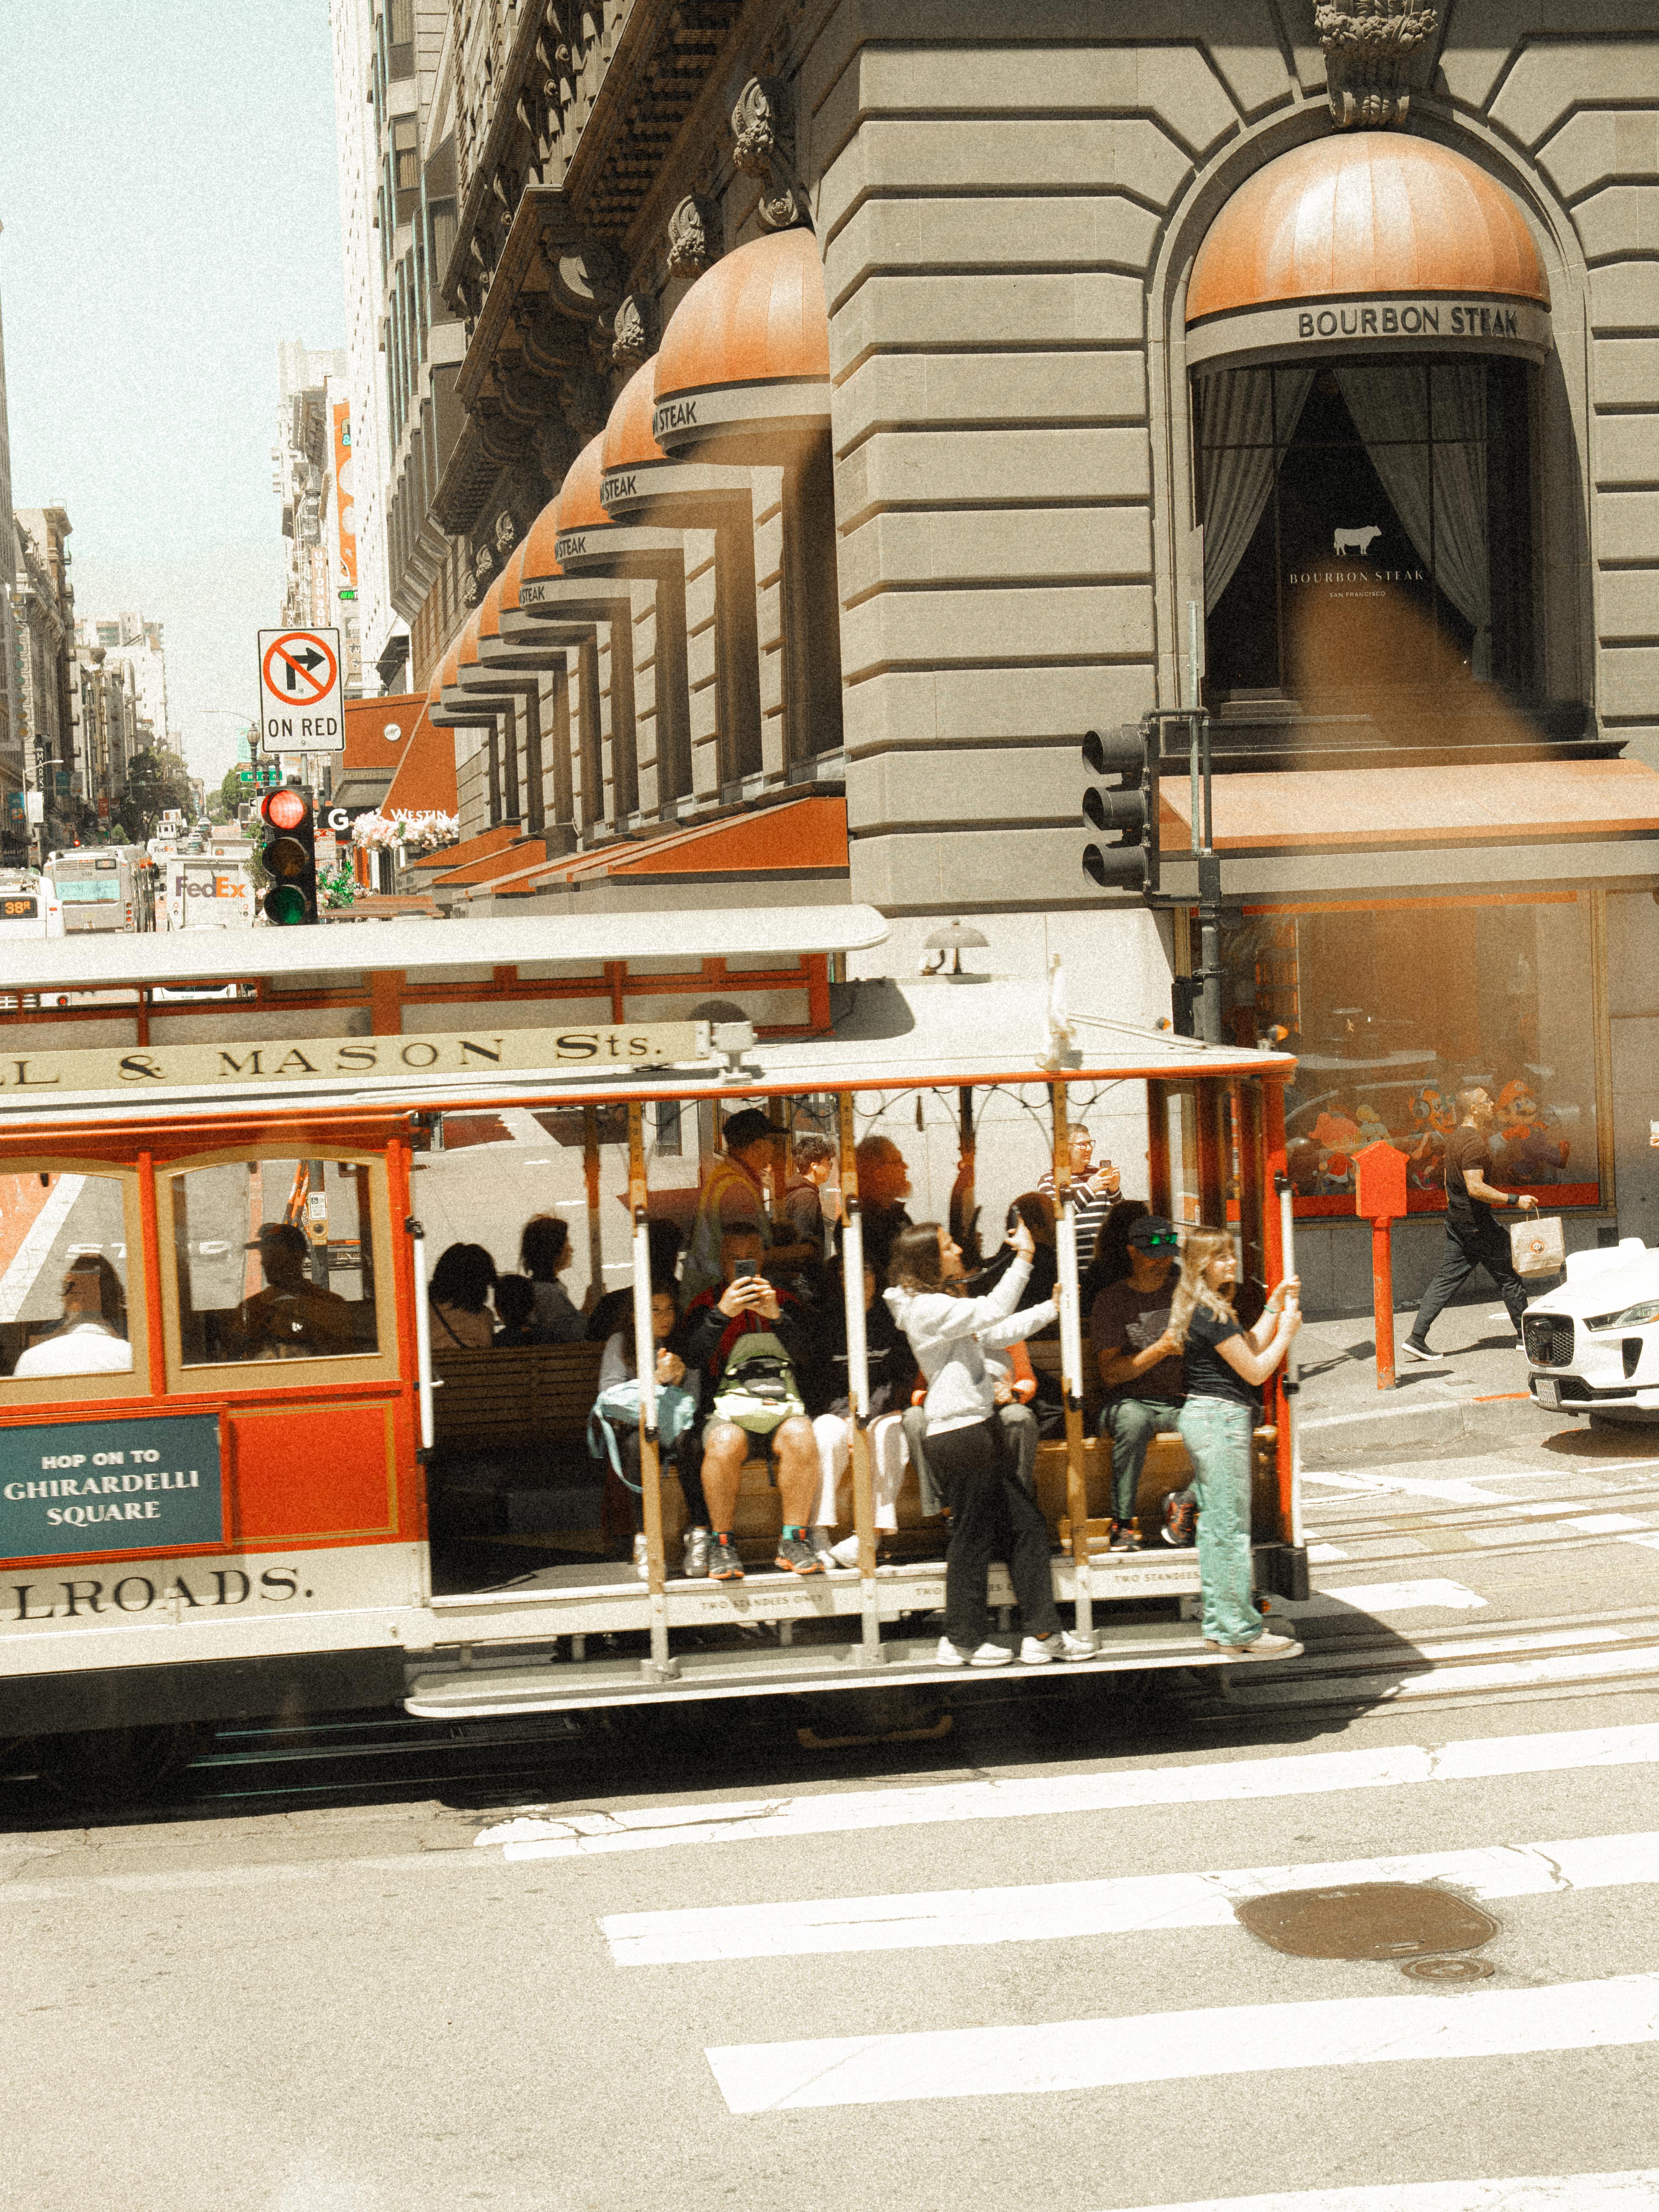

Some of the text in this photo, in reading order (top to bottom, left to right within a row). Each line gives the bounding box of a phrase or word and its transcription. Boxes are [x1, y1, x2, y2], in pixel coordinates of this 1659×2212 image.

[1299, 306, 1517, 338] BOURBON STEAK
[660, 401, 697, 432] STEAK
[605, 475, 637, 501] STEAK
[559, 536, 586, 558] STEAK
[315, 551, 325, 596] UNION
[1291, 570, 1423, 584] BOURBON STEAK
[340, 591, 354, 599] NEW
[522, 585, 545, 604] STEAK
[268, 718, 337, 737] ON RED
[390, 808, 446, 821] WESTIN
[175, 876, 246, 898] FedEx
[5, 901, 31, 915] 38R
[0, 1033, 663, 1086] L & MASON Sts.
[41, 1449, 161, 1469] HOP ON TO
[3, 1470, 200, 1500] GHIRARDELLI
[46, 1501, 161, 1528] SQUARE
[1144, 1571, 1200, 1582] STANDEES
[0, 1567, 314, 1621] LROADS.
[915, 1587, 942, 1596] TWO
[701, 1601, 728, 1610] TWO
[732, 1597, 789, 1608] STANDEES
